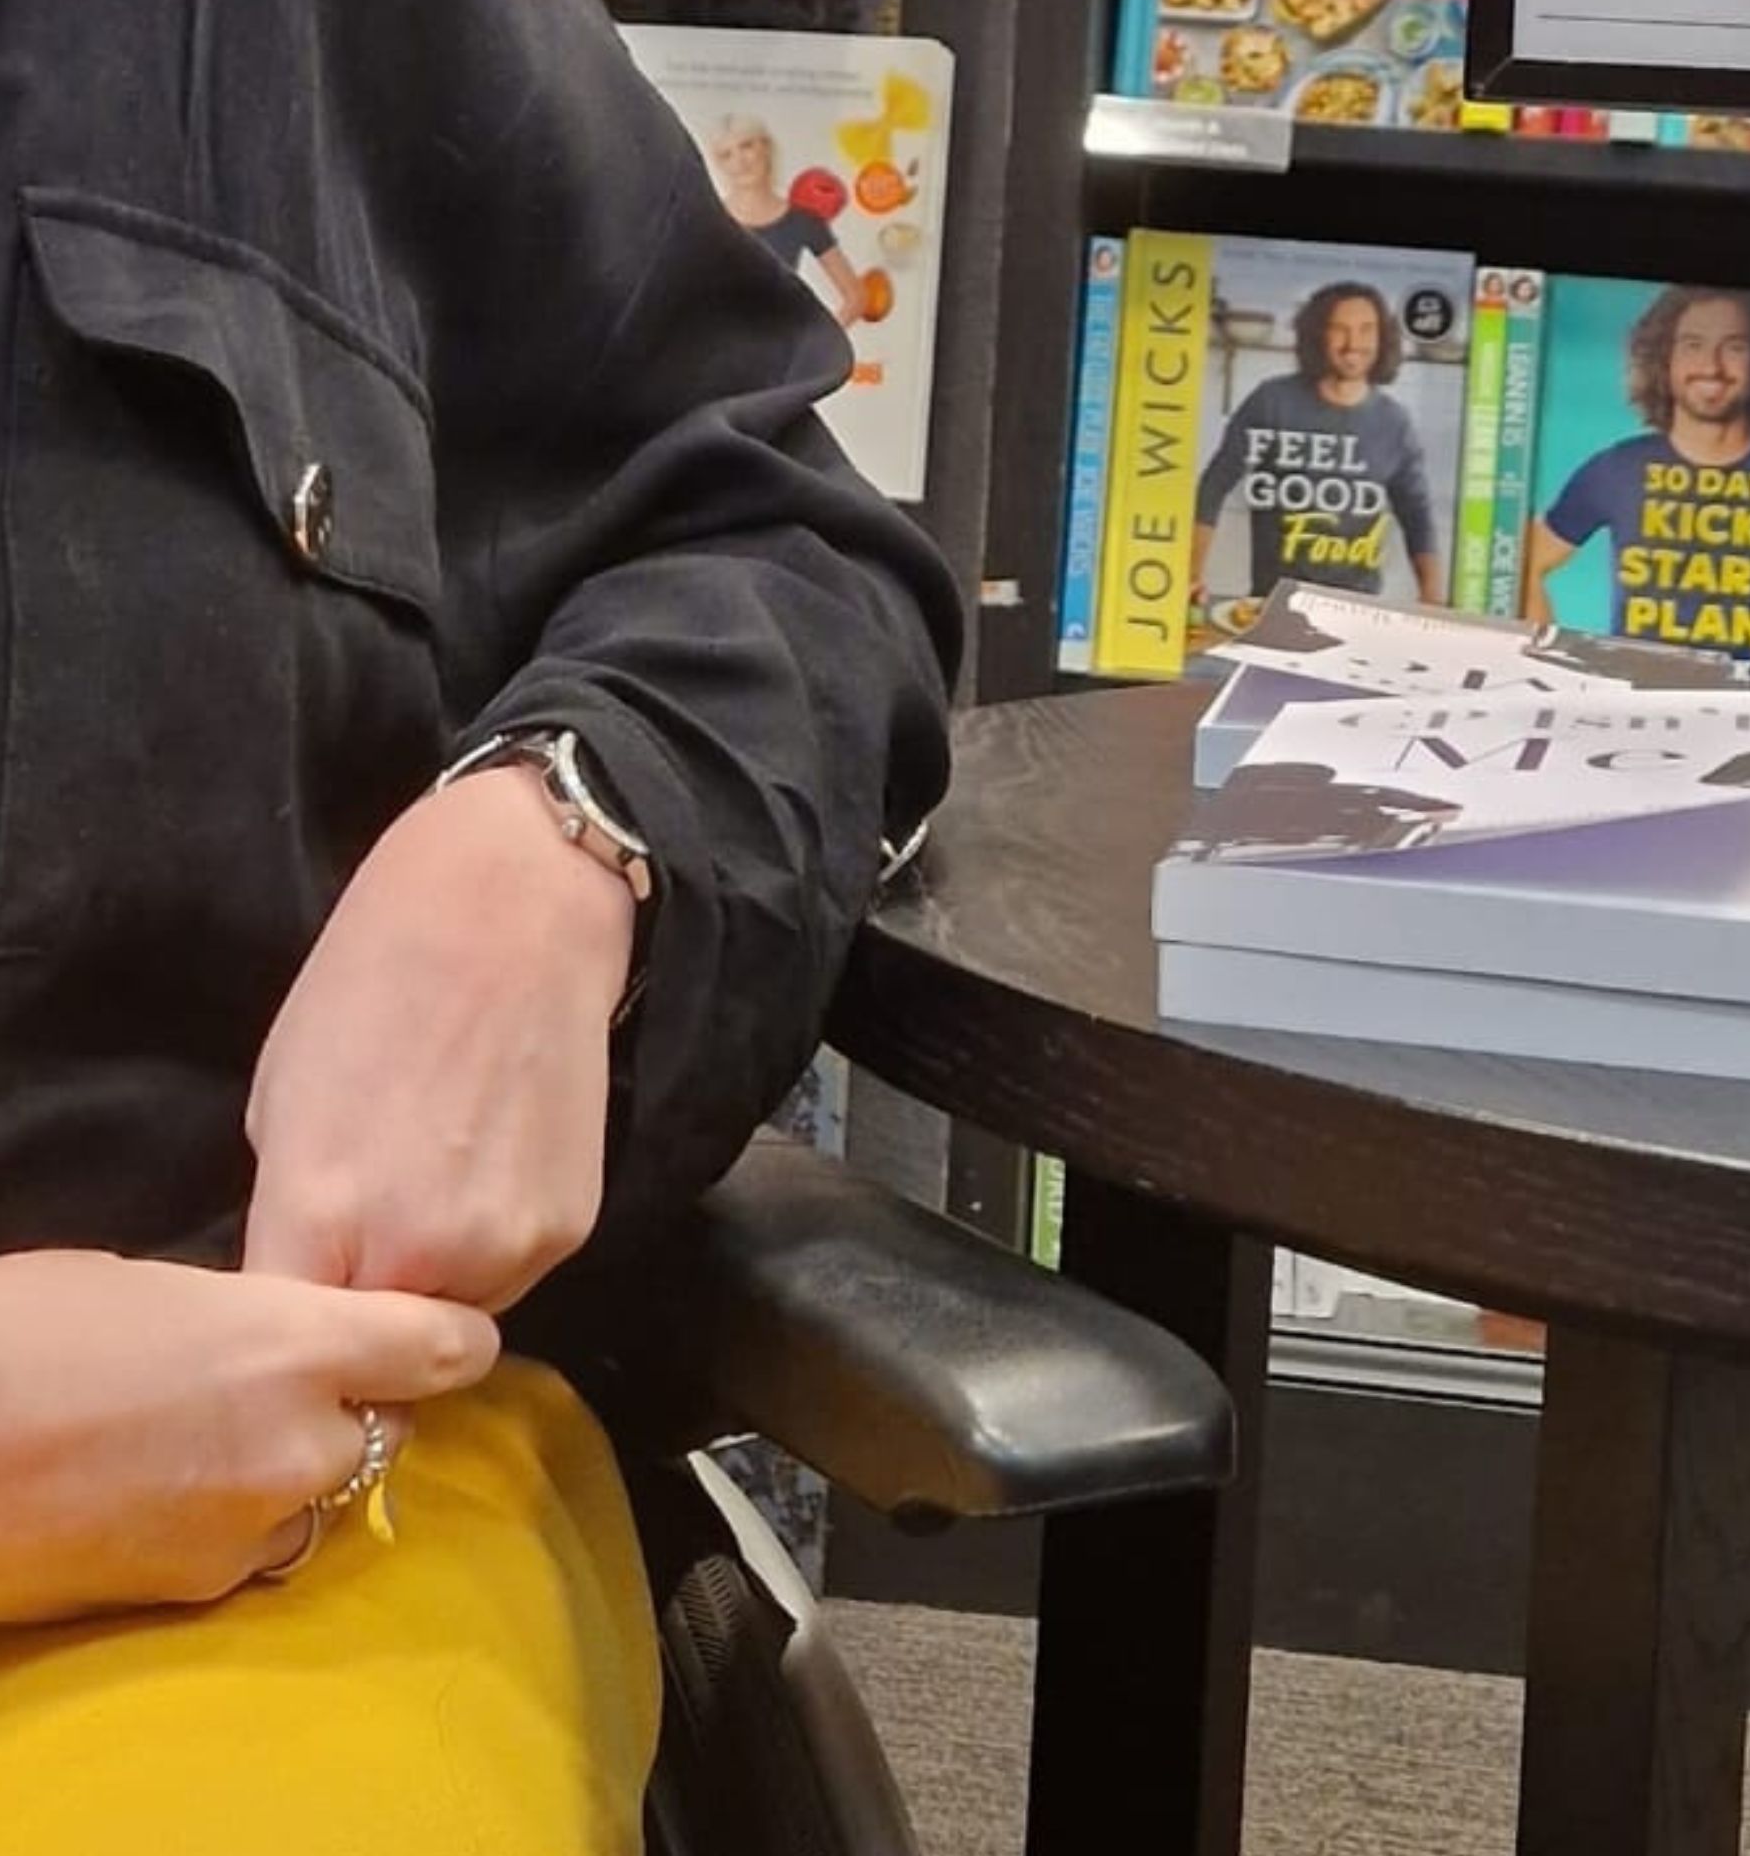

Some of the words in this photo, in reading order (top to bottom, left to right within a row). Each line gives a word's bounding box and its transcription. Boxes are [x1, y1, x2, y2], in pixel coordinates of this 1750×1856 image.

[1138, 259, 1198, 481] WICKS
[1247, 429, 1368, 473] FEEL
[1242, 473, 1386, 514] GOOD
[1279, 511, 1388, 571] Food
[1126, 512, 1178, 643] JOE
